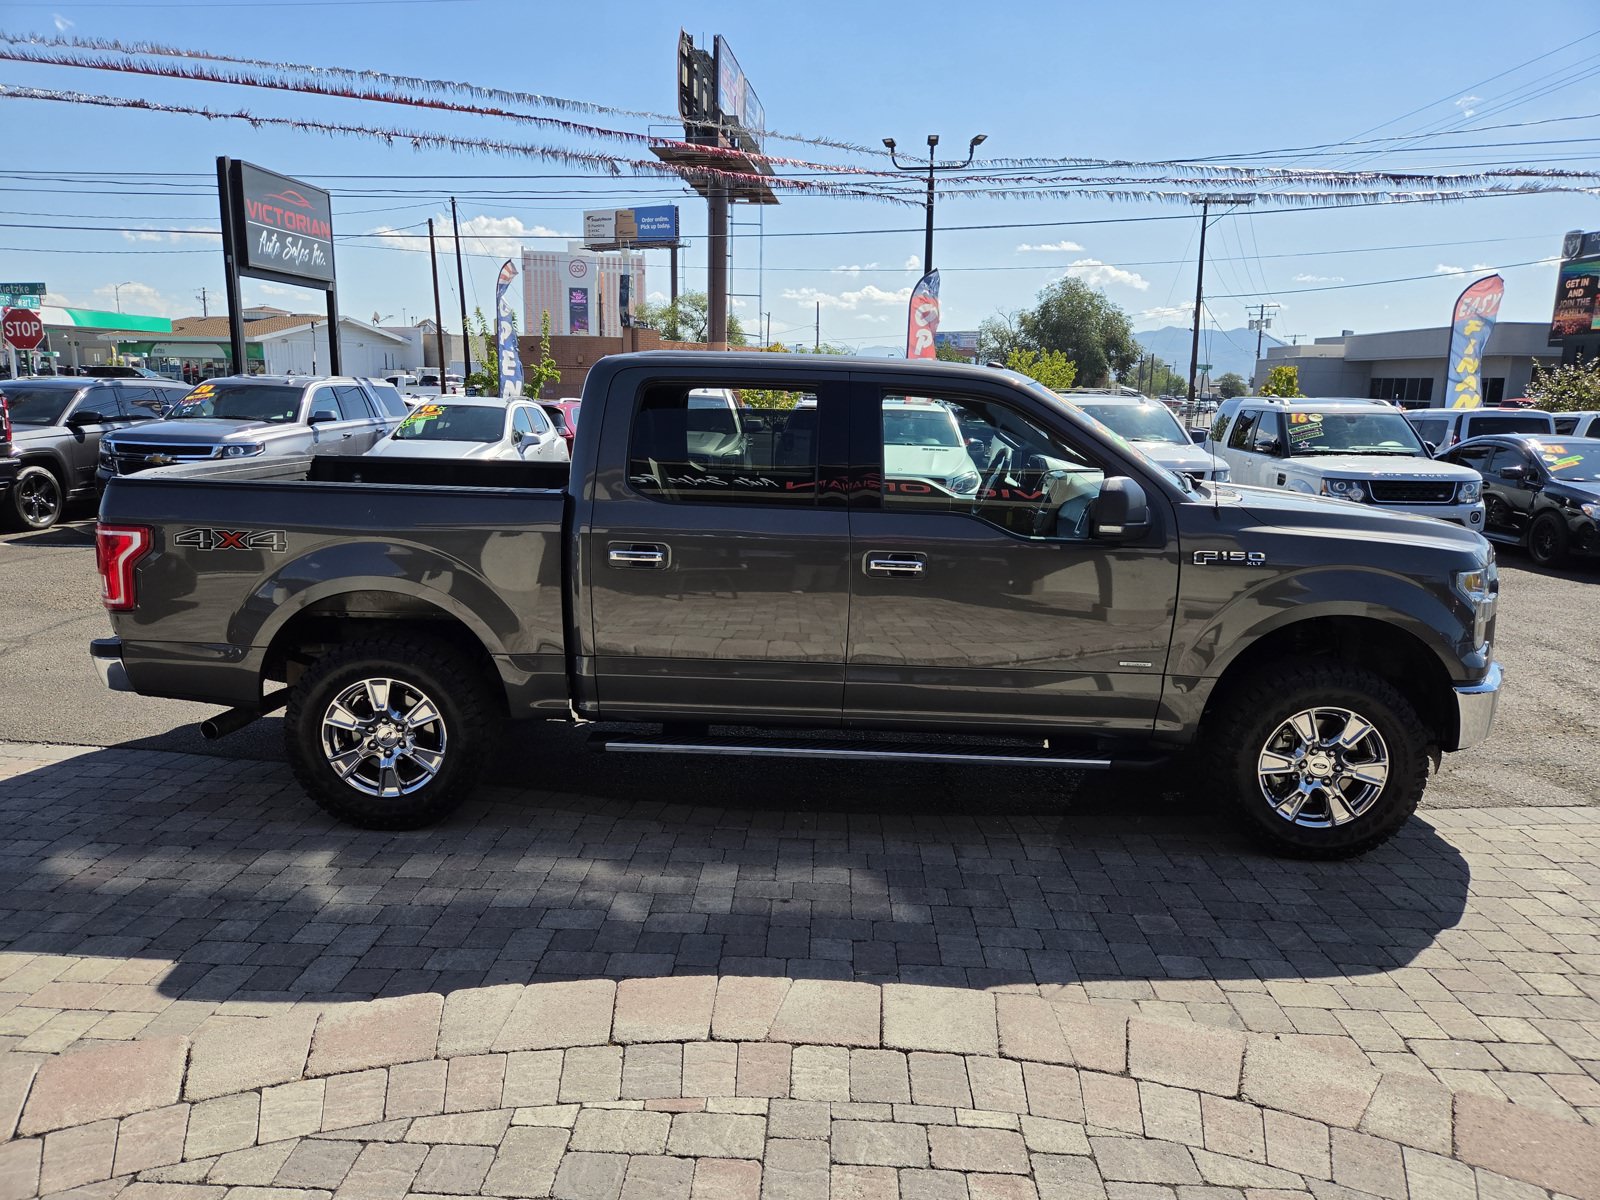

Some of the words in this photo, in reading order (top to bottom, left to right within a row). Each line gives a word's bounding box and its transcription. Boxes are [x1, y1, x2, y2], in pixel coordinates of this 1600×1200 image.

[246, 198, 330, 240] VICTORIAN
[282, 236, 309, 266] Sales
[571, 264, 585, 273] GSR
[1566, 280, 1579, 289] GET
[1581, 277, 1590, 286] IN
[1567, 288, 1584, 298] AND
[1459, 293, 1501, 318] EASY
[1576, 297, 1591, 306] THE
[5, 321, 40, 337] STOP
[1290, 413, 1308, 424] 16
